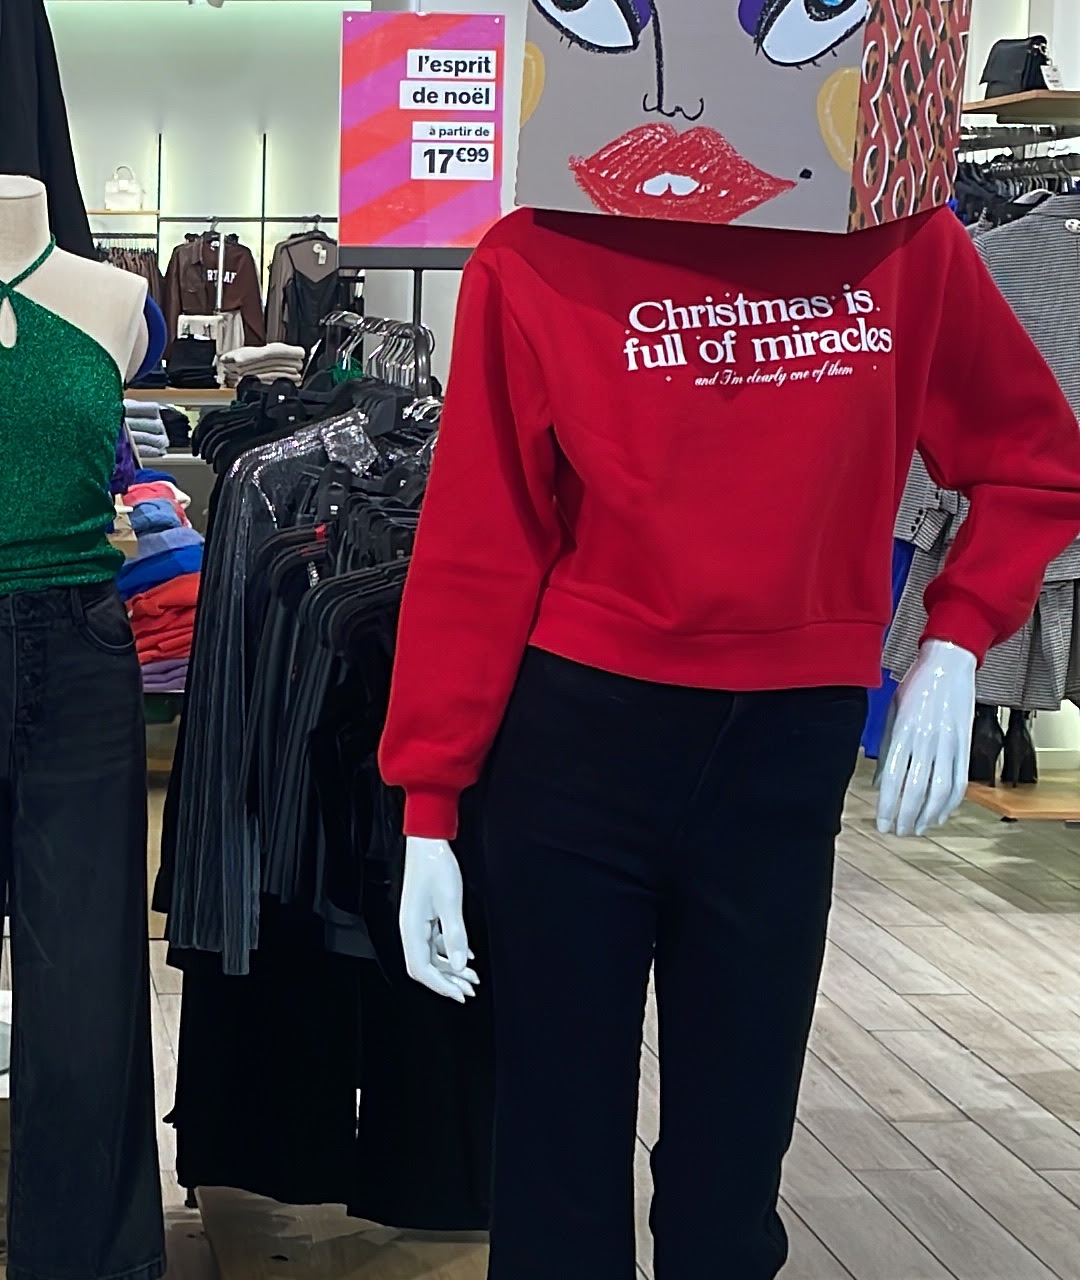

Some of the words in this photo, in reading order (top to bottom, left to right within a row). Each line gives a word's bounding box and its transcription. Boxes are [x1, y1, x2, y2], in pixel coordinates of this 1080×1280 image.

[412, 87, 439, 105] de
[444, 87, 490, 105] noël
[429, 126, 436, 136] à
[439, 126, 472, 139] partir
[475, 127, 490, 137] de
[628, 292, 833, 333] Christmas
[623, 332, 688, 371] full
[698, 330, 737, 364] of
[751, 317, 893, 362] miracles
[695, 371, 719, 386] and
[746, 366, 787, 387] clearly
[790, 370, 809, 381] one
[812, 360, 829, 383] of
[828, 359, 853, 376] them
